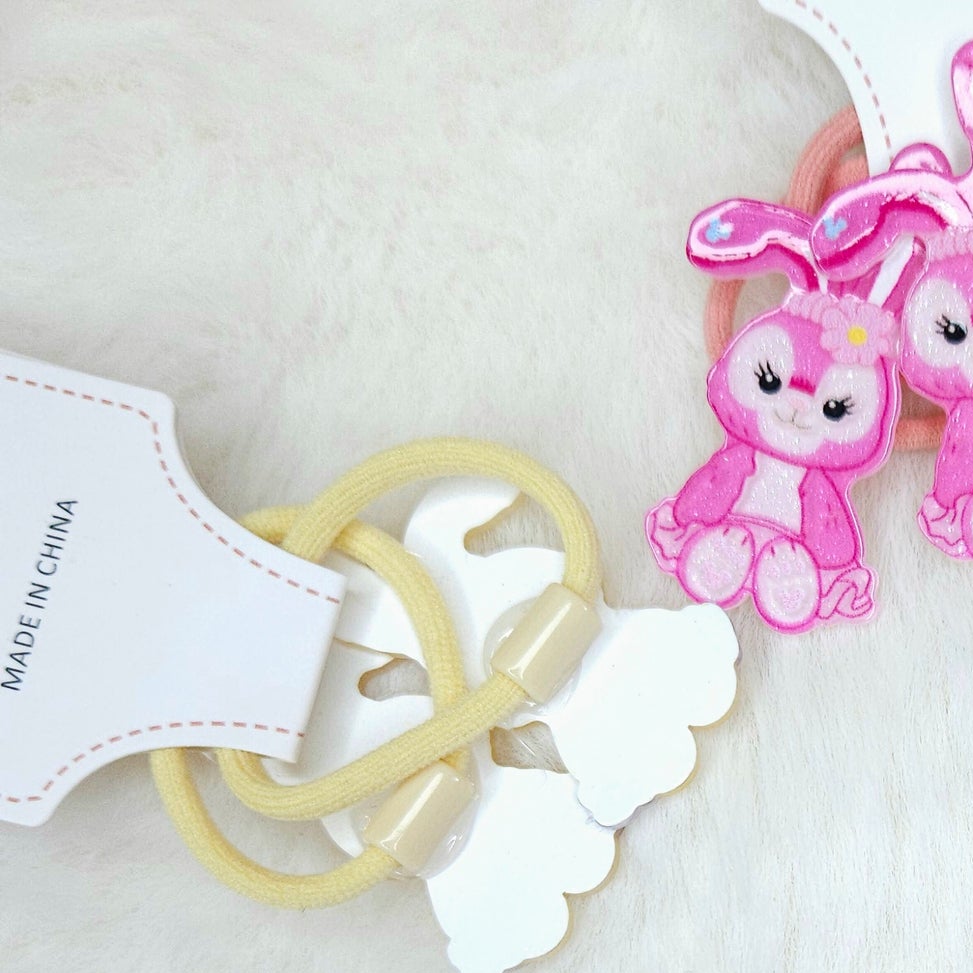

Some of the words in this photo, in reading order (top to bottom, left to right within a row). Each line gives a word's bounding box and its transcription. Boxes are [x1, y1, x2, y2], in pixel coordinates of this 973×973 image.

[36, 499, 79, 576] CHINA
[25, 582, 51, 609] IN
[1, 614, 42, 691] MADE
